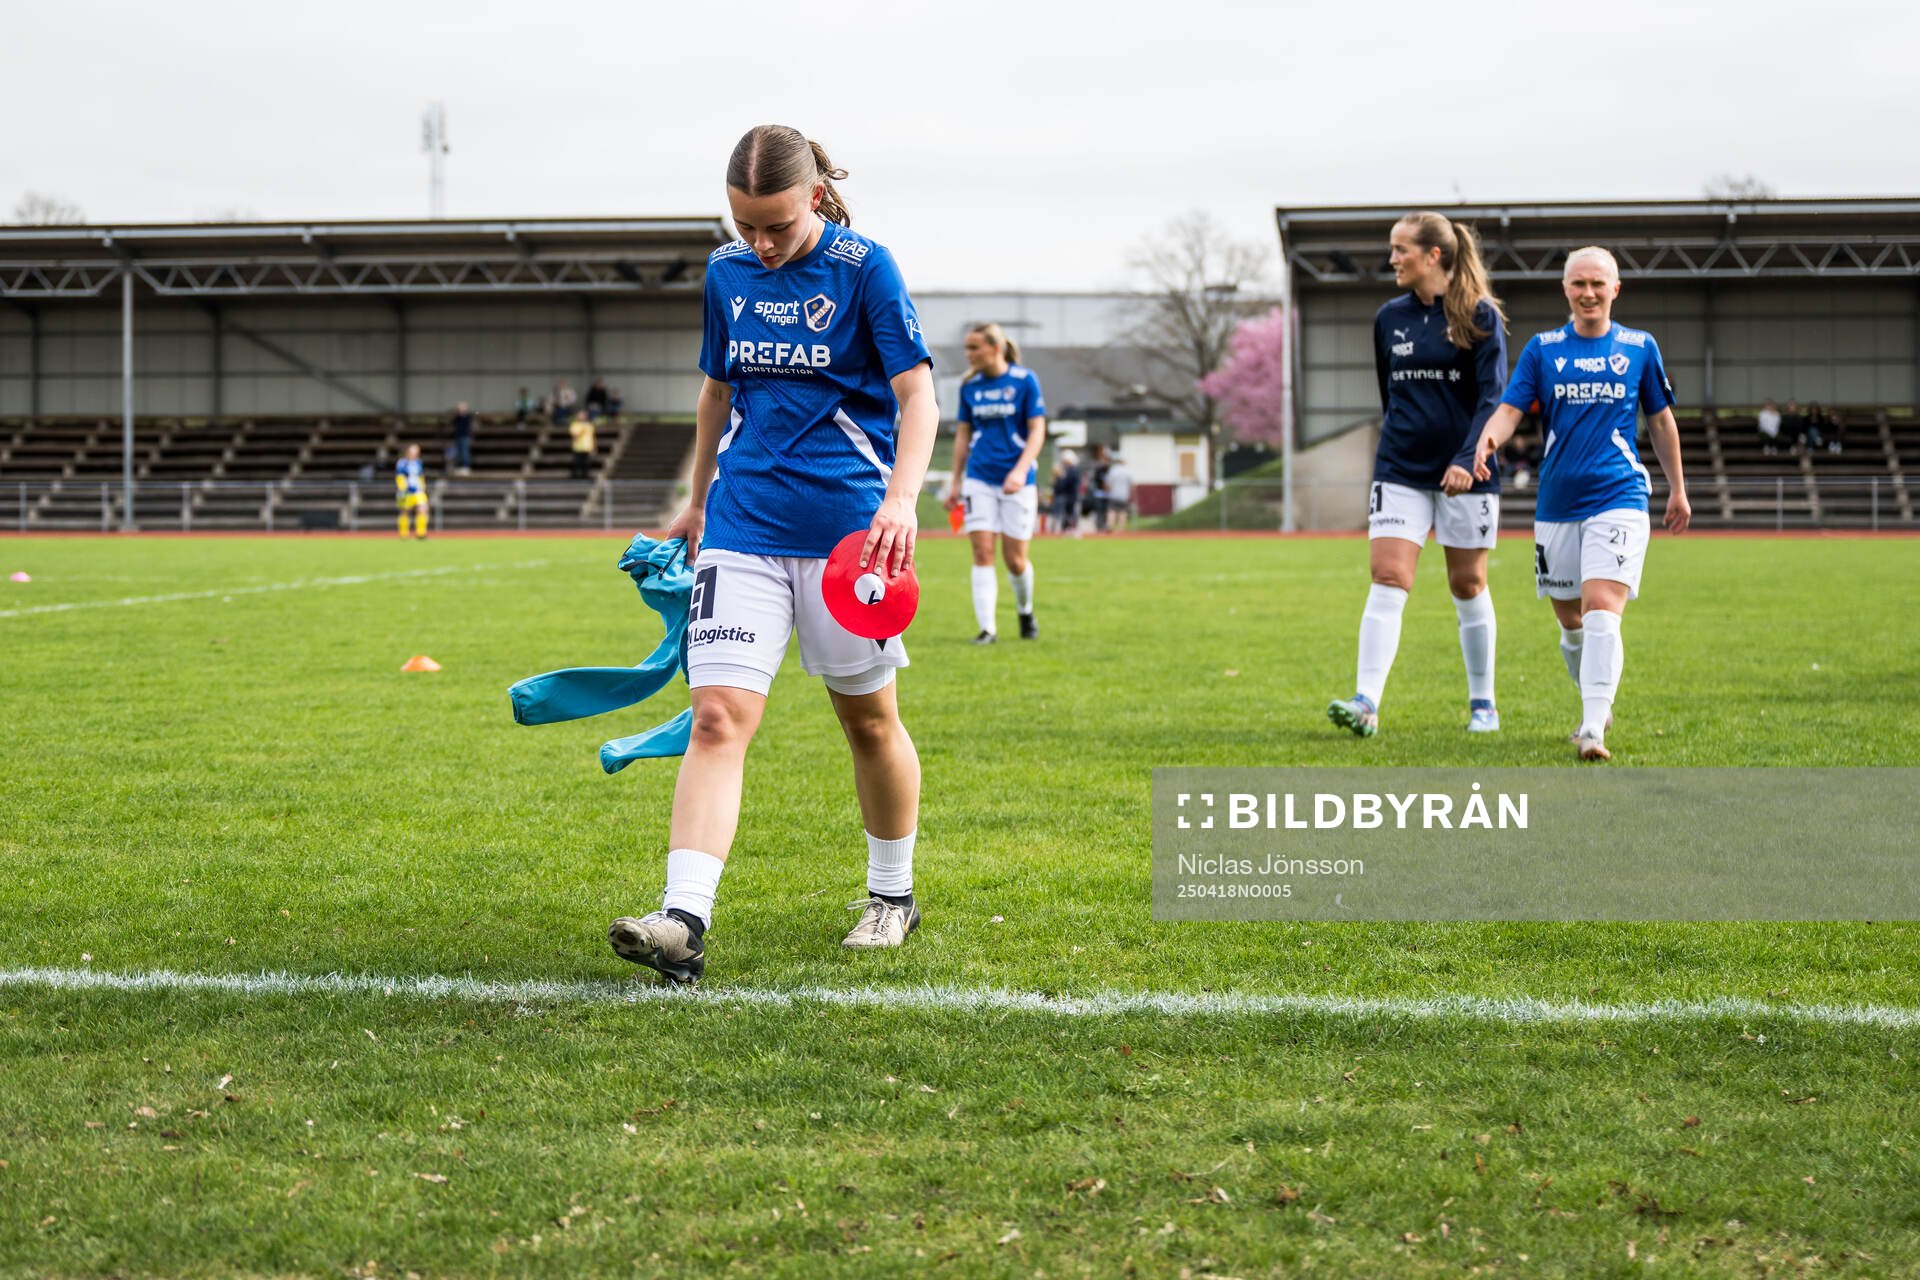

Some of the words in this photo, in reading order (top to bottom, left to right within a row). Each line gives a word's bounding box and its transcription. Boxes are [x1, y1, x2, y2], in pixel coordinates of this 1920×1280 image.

[831, 235, 869, 258] HFAB
[754, 301, 799, 317] sport
[729, 340, 831, 367] PREFAB
[742, 366, 813, 375] CONSTRUCTION
[1554, 382, 1626, 399] PREFAB
[1481, 500, 1489, 515] 3
[1609, 527, 1627, 546] 21
[694, 625, 756, 644] Logistics
